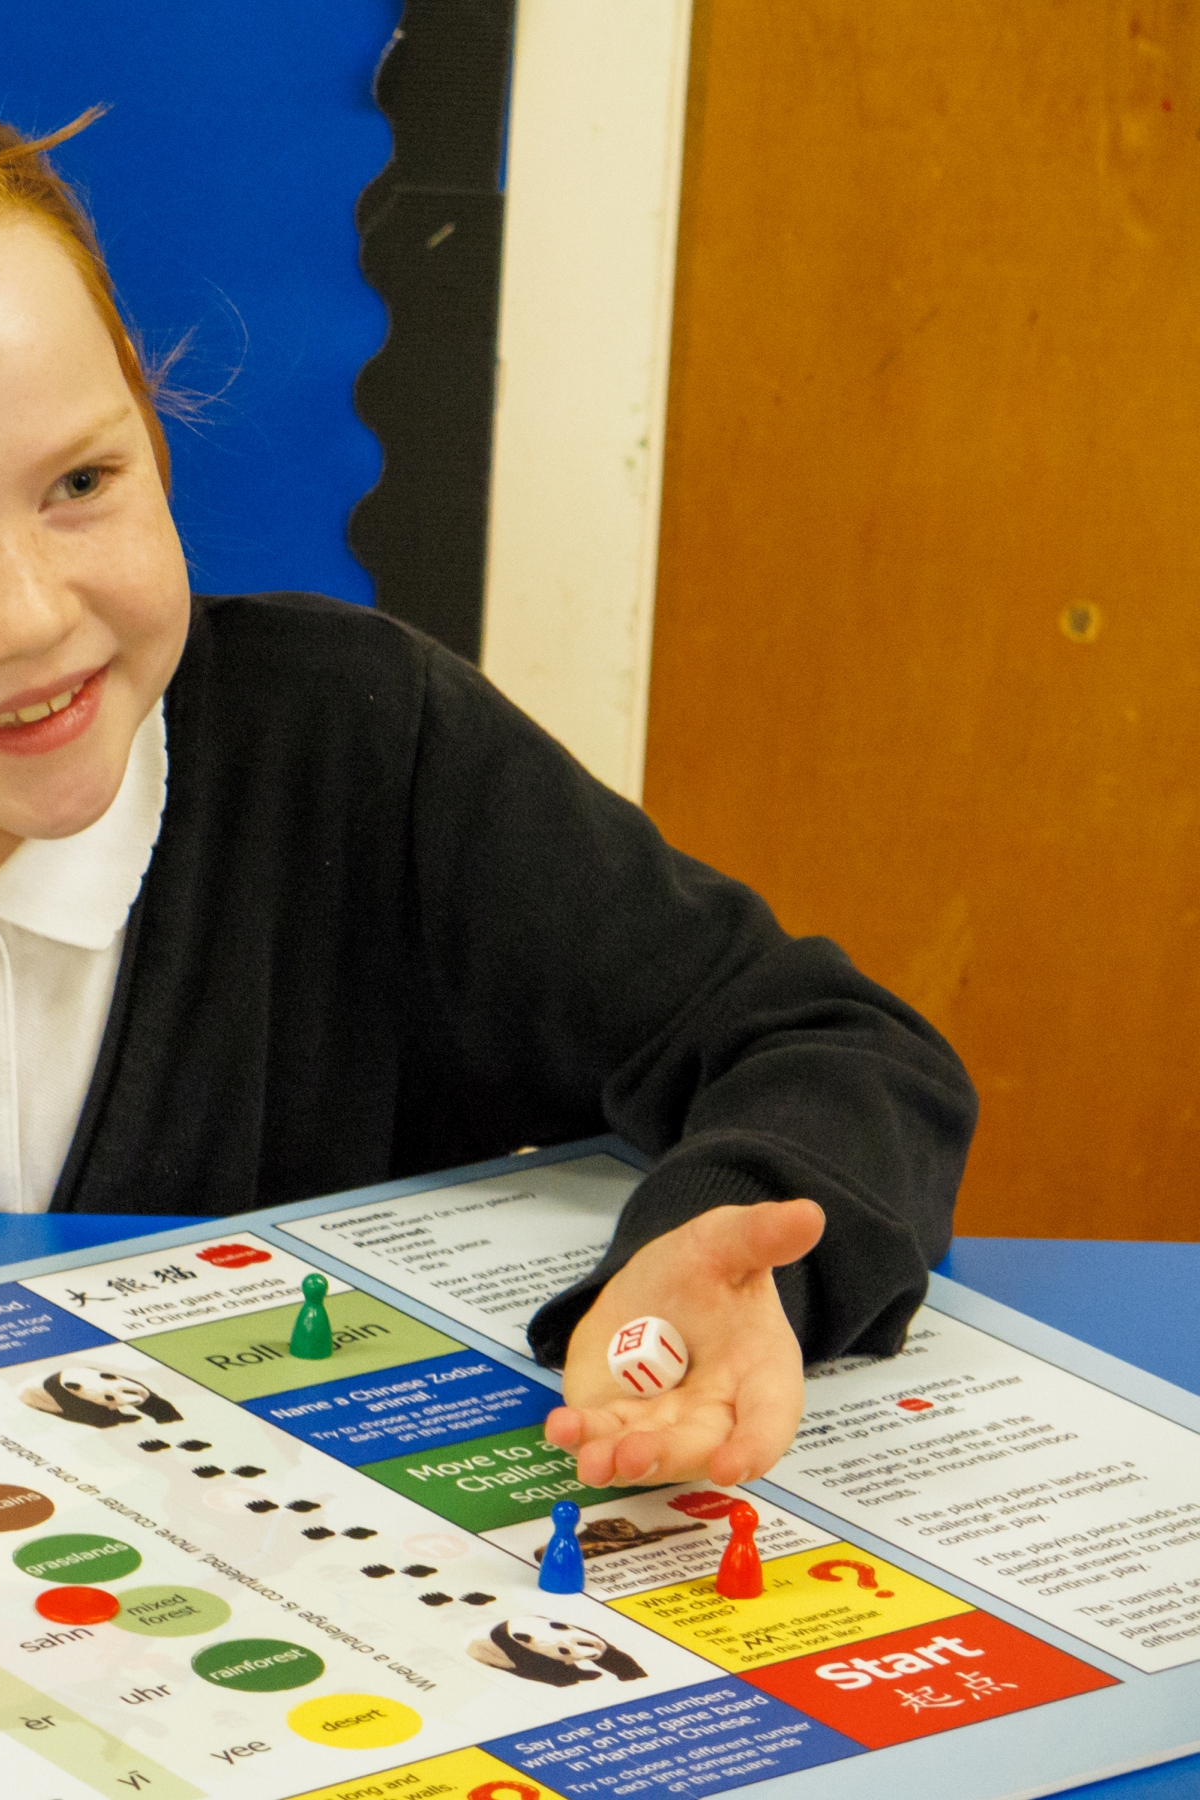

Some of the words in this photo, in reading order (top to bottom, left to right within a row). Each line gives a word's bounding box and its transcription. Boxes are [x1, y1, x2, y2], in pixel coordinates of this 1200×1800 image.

[126, 1303, 174, 1316] Write
[180, 1291, 224, 1306] giant
[229, 1279, 286, 1295] panda
[146, 1306, 219, 1324] Chinese
[222, 1286, 302, 1309] character
[205, 1344, 283, 1370] Roll
[270, 1401, 332, 1419] Name
[334, 1397, 350, 1406] a
[349, 1379, 428, 1401] Chinese
[425, 1364, 493, 1384] Zodiac
[799, 1466, 837, 1477] The
[838, 1458, 870, 1469] aim
[869, 1450, 891, 1461] is
[882, 1445, 911, 1456] to
[909, 1429, 980, 1451] complete
[983, 1422, 1004, 1432] all
[1002, 1416, 1034, 1425] the
[46, 1467, 79, 1482] one
[406, 1456, 496, 1481] Move
[492, 1446, 533, 1461] to
[456, 1456, 577, 1492] Challen
[76, 1484, 101, 1495] up
[510, 1479, 586, 1504] squa
[896, 1516, 913, 1526] If
[913, 1511, 943, 1521] the
[947, 1495, 1009, 1515] playing
[1006, 1483, 1052, 1499] piece
[1049, 1471, 1097, 1486] lands
[1097, 1465, 1121, 1473] on
[918, 1513, 997, 1536] challenge
[997, 1496, 1058, 1515] already
[1058, 1472, 1148, 1499] completed,
[97, 1497, 157, 1528] counter
[155, 1529, 199, 1553] move
[25, 1540, 129, 1577] grasslands
[198, 1553, 284, 1601] completed,
[127, 1594, 187, 1616] mixed
[281, 1602, 300, 1611] is
[637, 1592, 686, 1609] What
[690, 1585, 714, 1598] do
[654, 1607, 687, 1618] the
[138, 1605, 200, 1626] forest
[673, 1605, 736, 1627] means?
[20, 1624, 94, 1652] sahn
[297, 1611, 375, 1653] challenge
[209, 1649, 307, 1680] rainforest
[373, 1654, 390, 1662] a
[815, 1636, 985, 1690] Start
[387, 1662, 436, 1691] When
[120, 1685, 171, 1704] uhr
[894, 1671, 1018, 1714] 起点
[322, 1709, 386, 1732] desert
[515, 1738, 555, 1754] Say
[557, 1727, 595, 1743] one
[595, 1718, 617, 1731] of
[616, 1712, 653, 1724] the
[653, 1689, 736, 1716] numbers
[521, 1745, 591, 1769] written
[592, 1736, 619, 1749] on
[617, 1726, 657, 1740] this
[658, 1711, 713, 1732] game
[709, 1694, 769, 1716] board
[211, 1741, 271, 1765] yee
[566, 1761, 591, 1771] in
[588, 1736, 680, 1765] Mandarin
